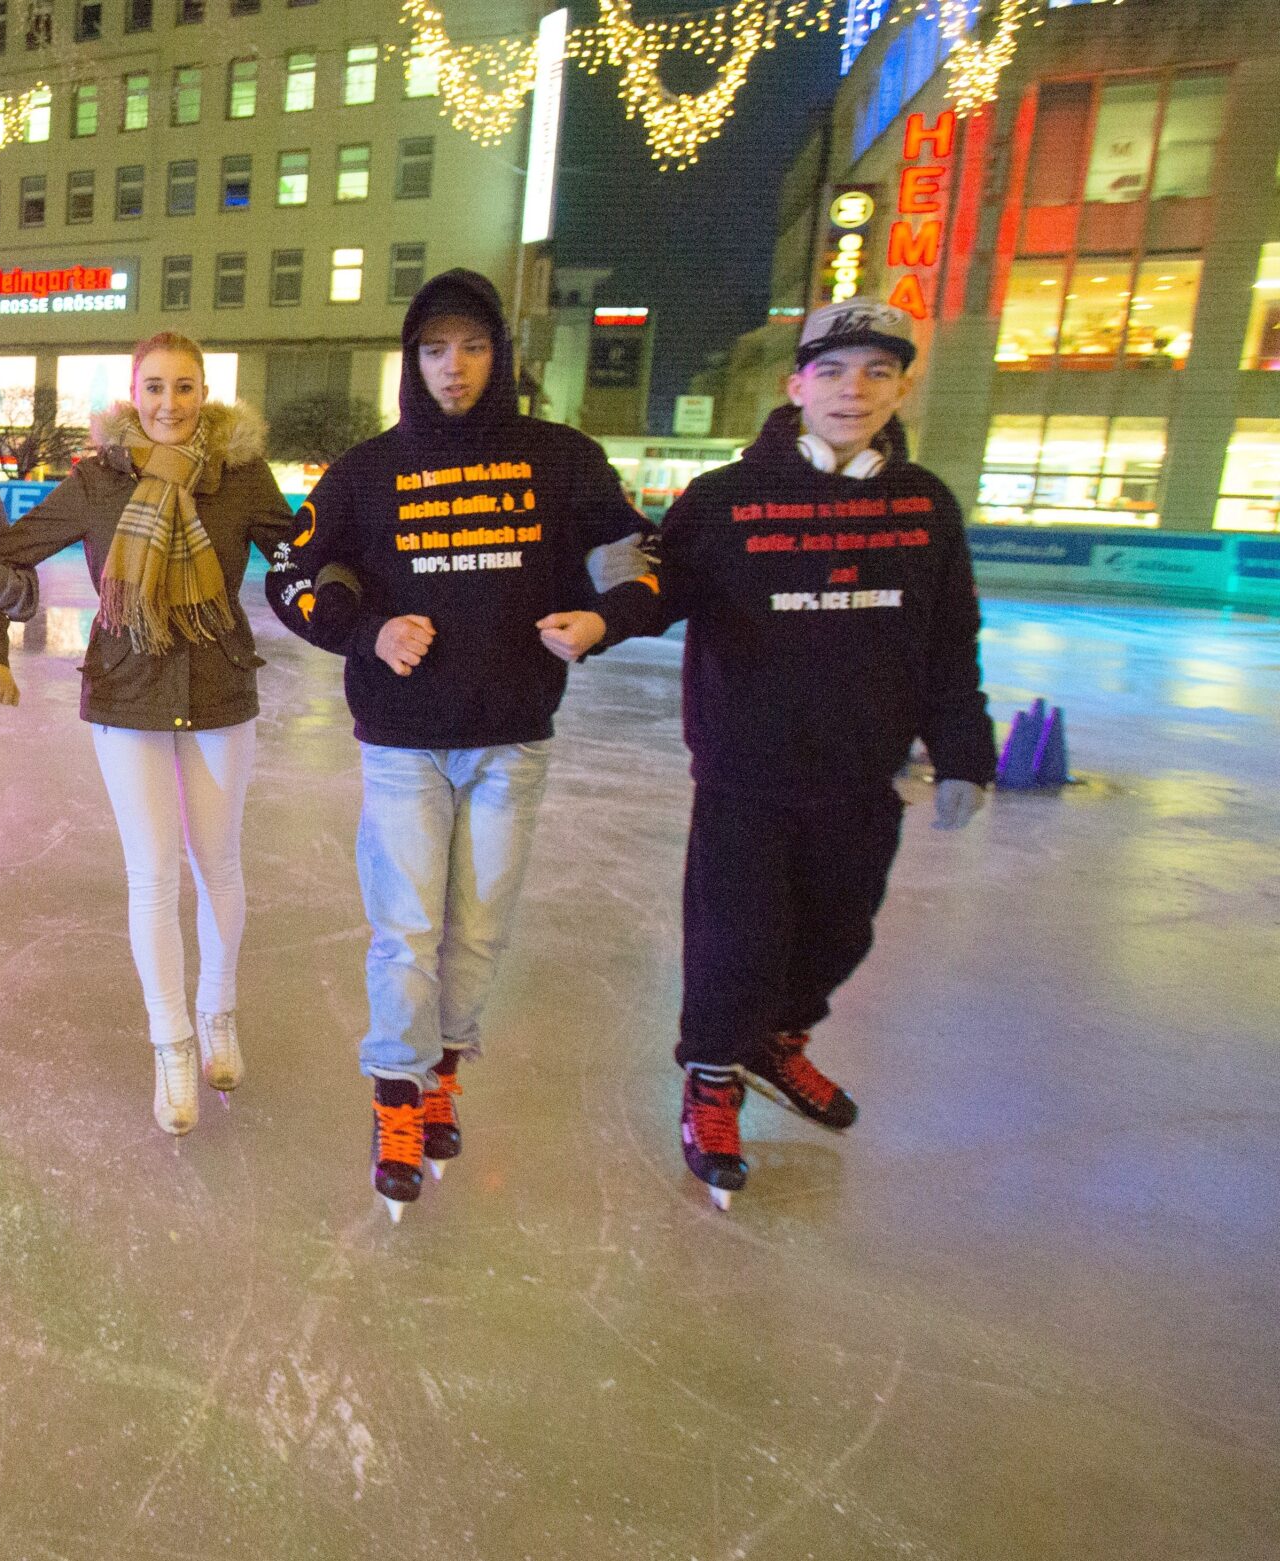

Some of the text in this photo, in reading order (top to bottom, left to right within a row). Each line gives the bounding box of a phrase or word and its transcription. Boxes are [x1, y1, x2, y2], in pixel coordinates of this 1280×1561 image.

[885, 110, 956, 319] HEMA
[52, 294, 127, 312] GRÖSSEN
[422, 470, 462, 488] kann
[463, 462, 532, 481] wirklich
[400, 501, 450, 520] nichts
[422, 531, 450, 549] bin
[451, 525, 515, 547] einfach
[517, 523, 542, 542] so!
[411, 551, 523, 574] 100% ICE FREAK
[821, 591, 851, 610] ICE
